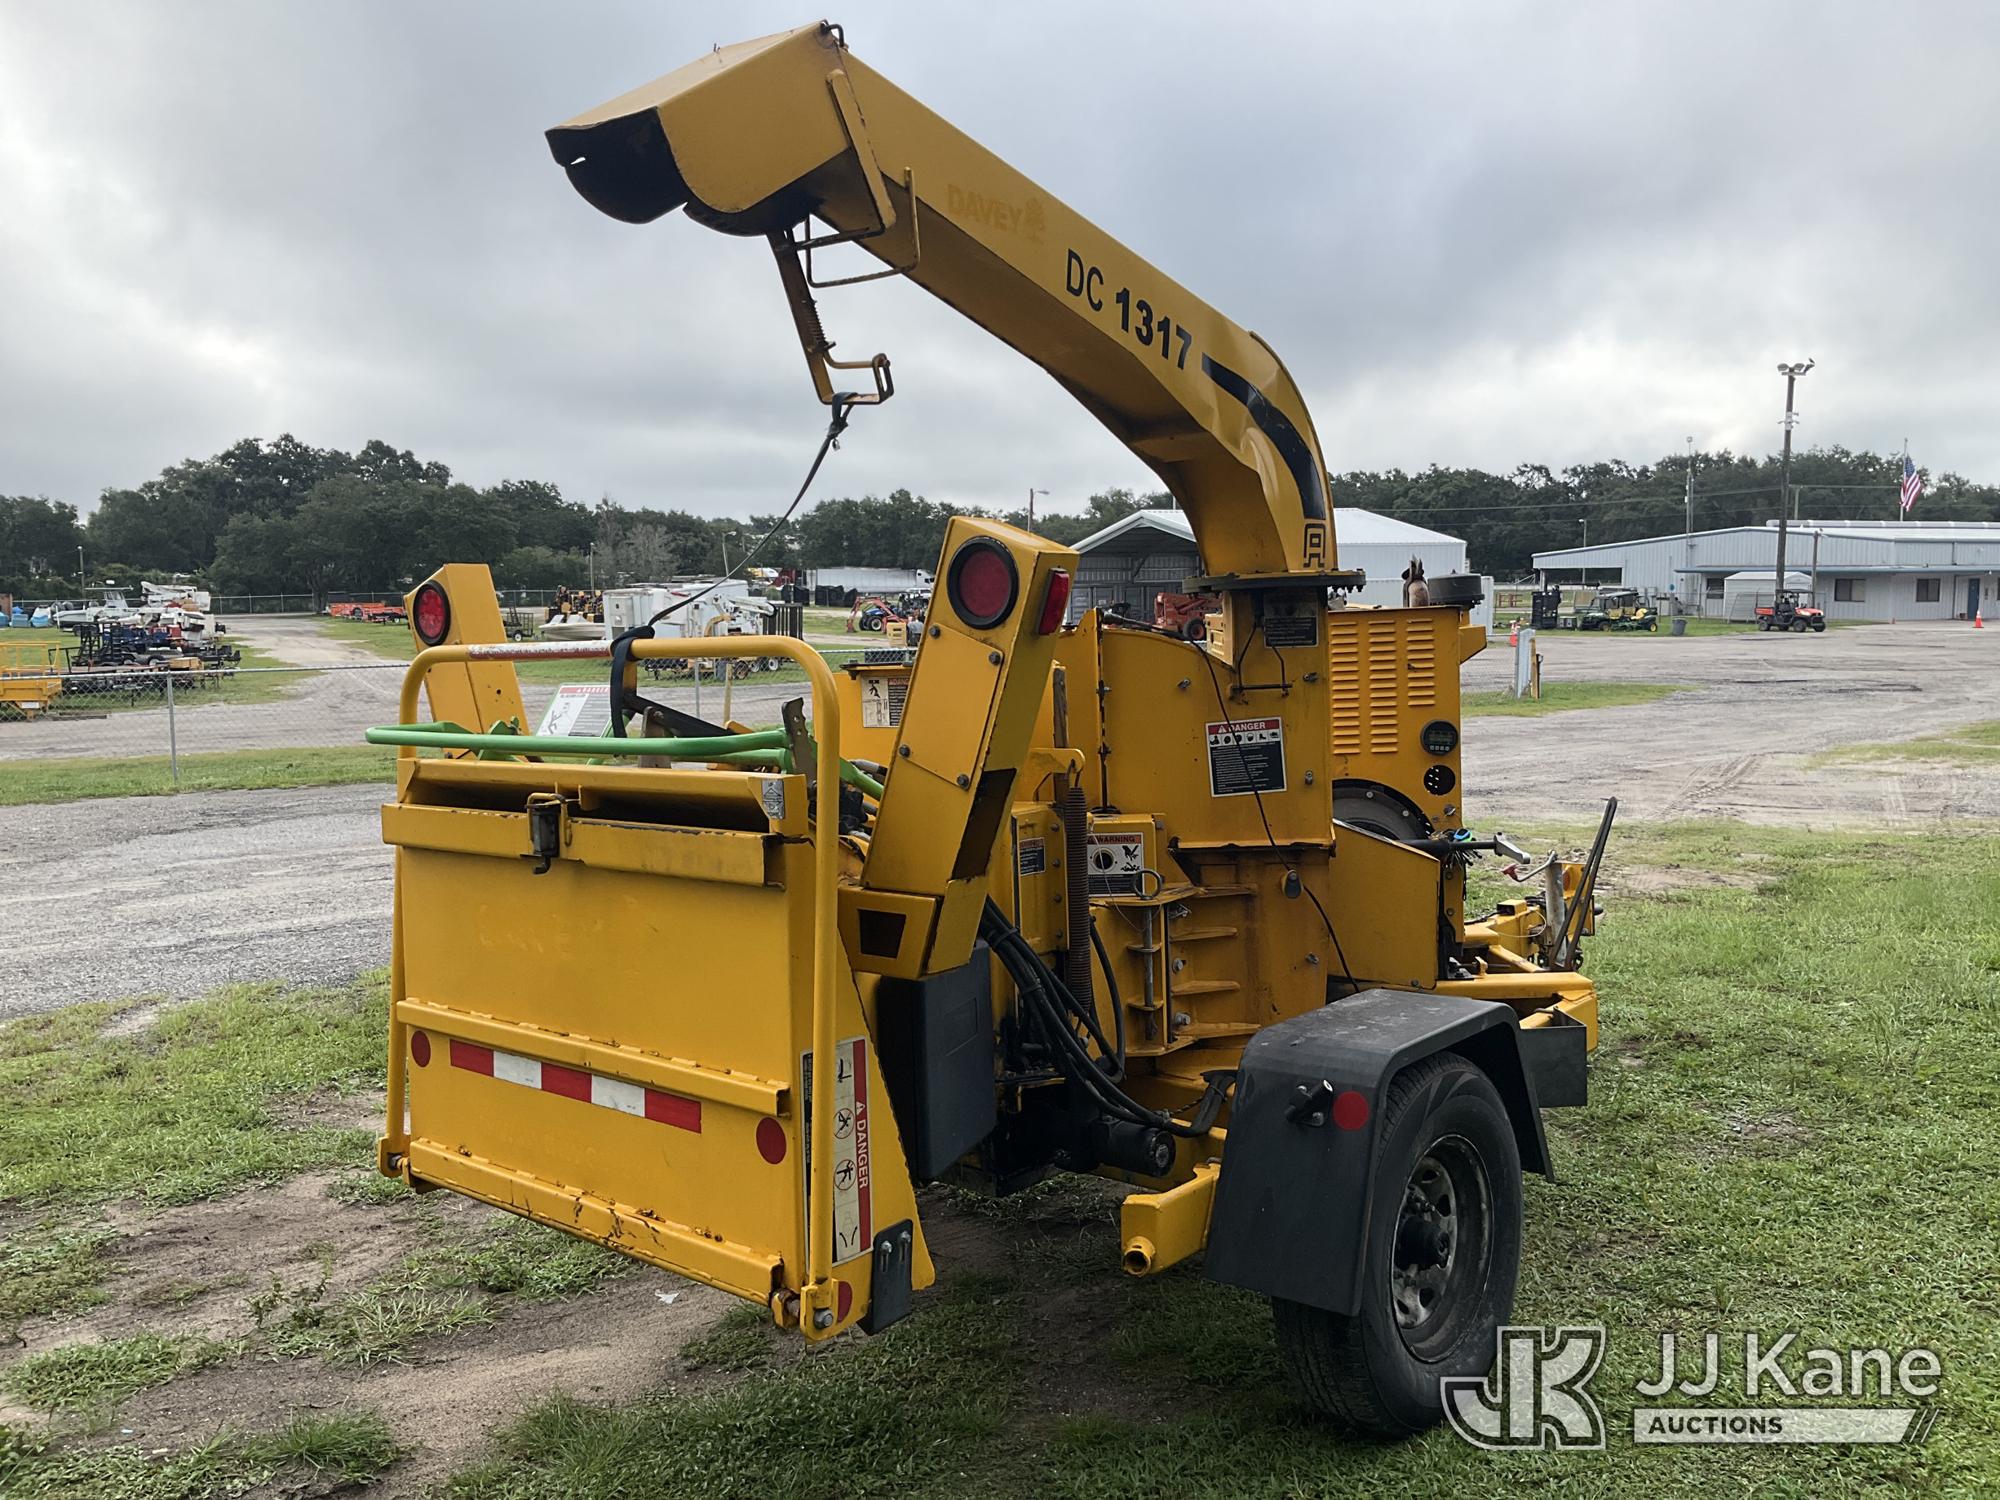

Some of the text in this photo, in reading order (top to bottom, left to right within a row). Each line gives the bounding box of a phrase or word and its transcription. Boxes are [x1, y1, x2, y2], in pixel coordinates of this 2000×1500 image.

[947, 185, 1024, 233] DAVEY
[1066, 248, 1192, 370] DC 1317
[1228, 721, 1266, 732] DANGER
[1097, 835, 1136, 843] WARNING
[855, 1119, 870, 1189] DANGER
